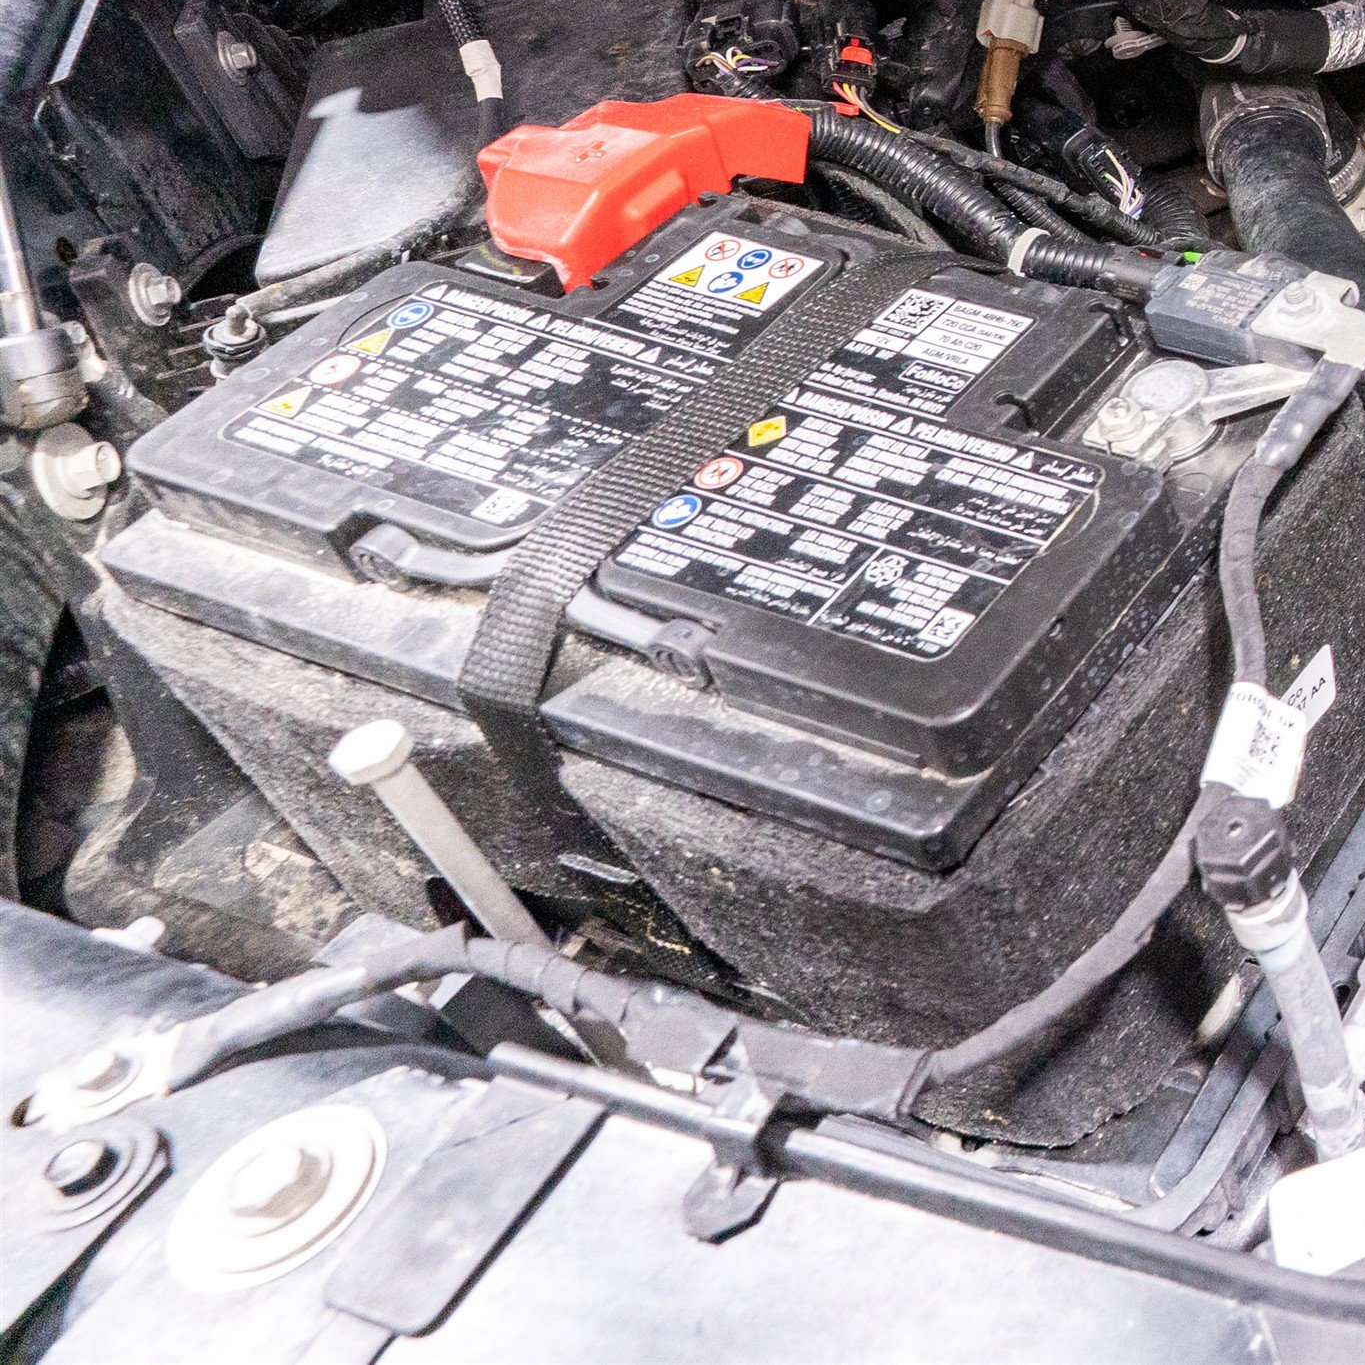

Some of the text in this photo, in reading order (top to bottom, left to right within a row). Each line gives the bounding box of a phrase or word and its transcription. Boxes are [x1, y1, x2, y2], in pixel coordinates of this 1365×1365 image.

[939, 317, 960, 328] 720
[956, 322, 979, 333] CCA
[872, 334, 893, 346] 12V
[936, 333, 953, 343] 70
[961, 340, 984, 352] C20
[903, 364, 969, 390] FoMoCo
[791, 390, 899, 430] DANGER/POISON
[906, 422, 1020, 463] PELIGRO/VENENO
